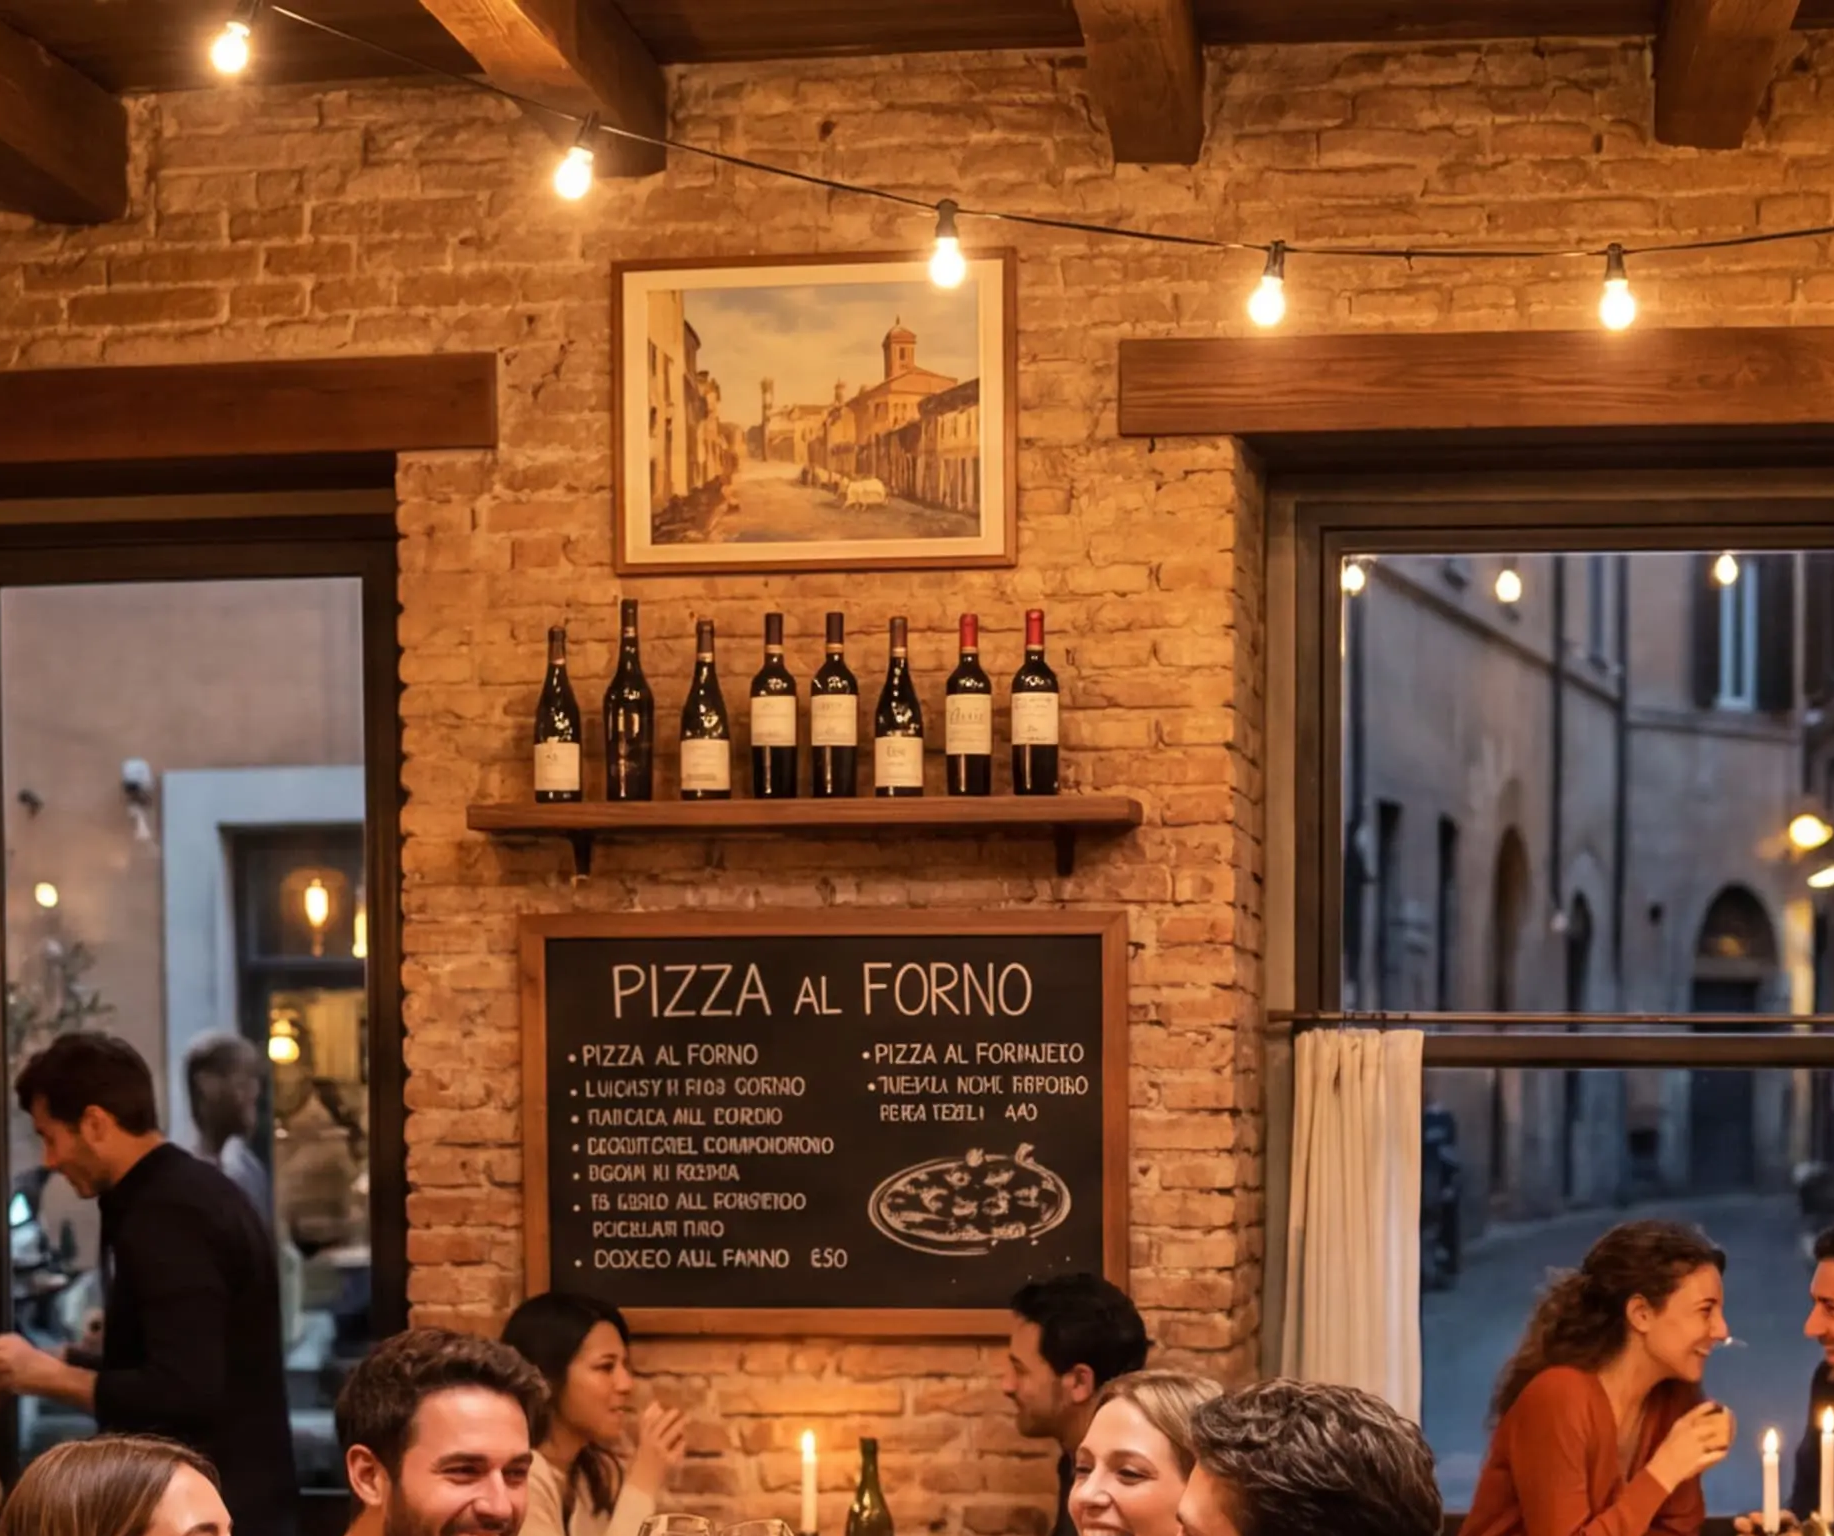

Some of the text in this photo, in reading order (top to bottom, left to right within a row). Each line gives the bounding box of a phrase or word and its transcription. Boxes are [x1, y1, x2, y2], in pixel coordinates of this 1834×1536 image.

[612, 962, 1032, 1019] PIZZA AL FORNO
[582, 1043, 759, 1067] PIZZA AL FORNO
[874, 1043, 937, 1065] PIZZA
[943, 1043, 969, 1065] AL
